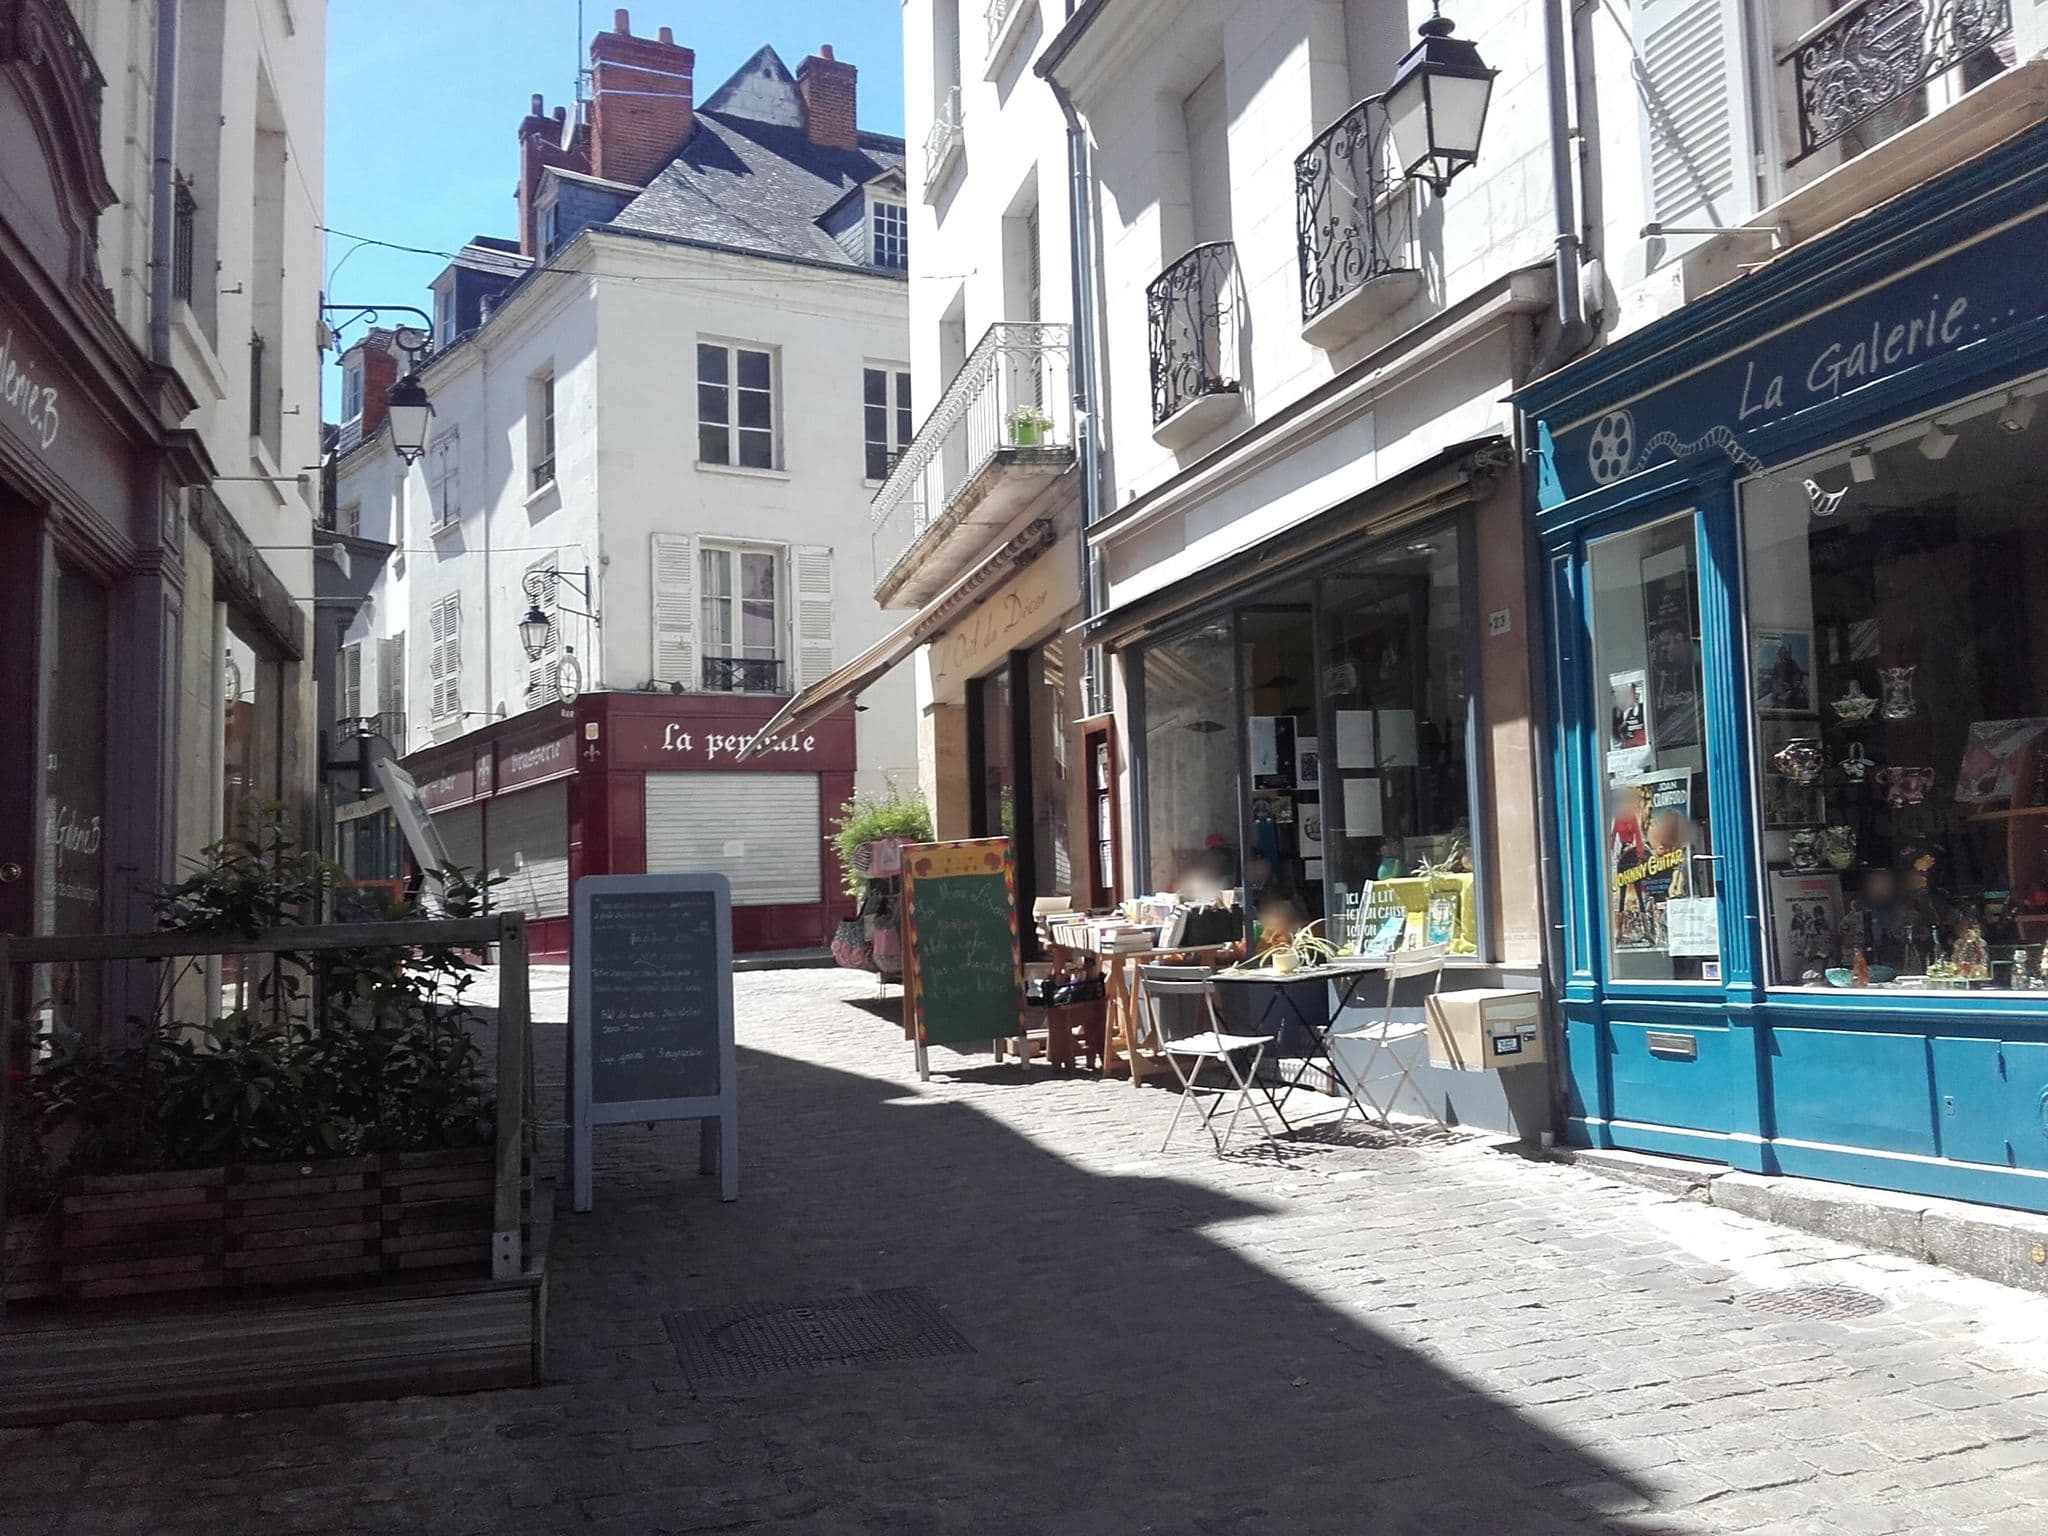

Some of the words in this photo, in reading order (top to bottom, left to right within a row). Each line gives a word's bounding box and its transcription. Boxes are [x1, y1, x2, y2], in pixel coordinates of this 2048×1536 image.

[1739, 361, 1784, 421] La
[661, 723, 693, 752] La
[1658, 781, 1678, 791] JOAN
[1653, 790, 1687, 808] CRAWFORD
[1612, 862, 1647, 891] JOHNNY
[1648, 848, 1685, 875] GUITAR
[1346, 892, 1359, 905] ICI
